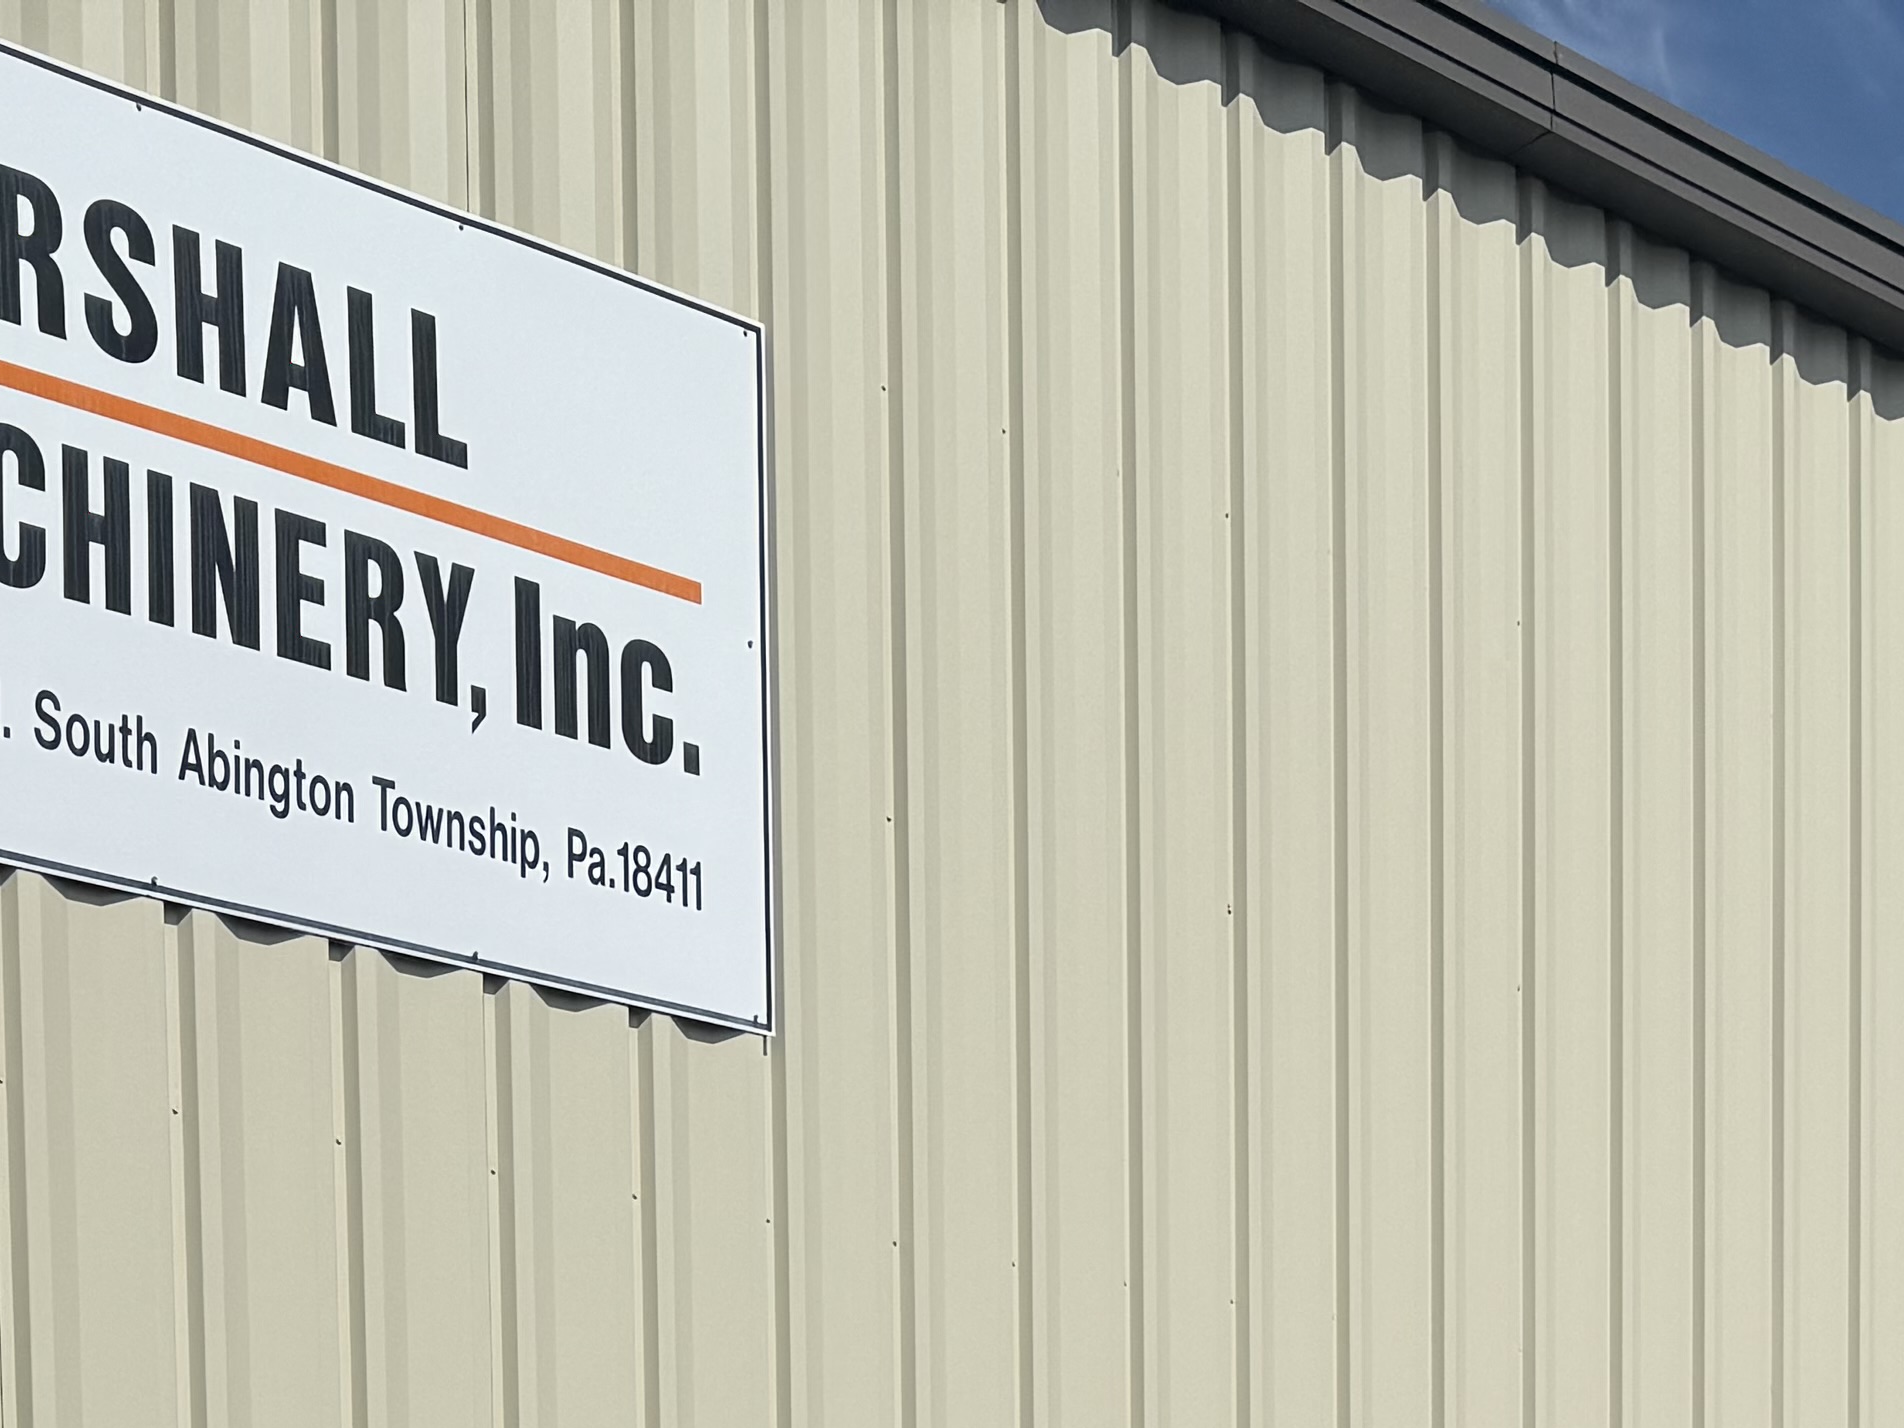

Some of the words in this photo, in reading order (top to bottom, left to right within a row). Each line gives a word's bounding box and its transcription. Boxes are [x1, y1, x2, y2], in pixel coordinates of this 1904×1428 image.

[514, 575, 701, 777] Inc.
[33, 689, 158, 775] South
[177, 727, 355, 820] Abington
[371, 775, 551, 884] Township,
[566, 826, 703, 912] Pa.18411
